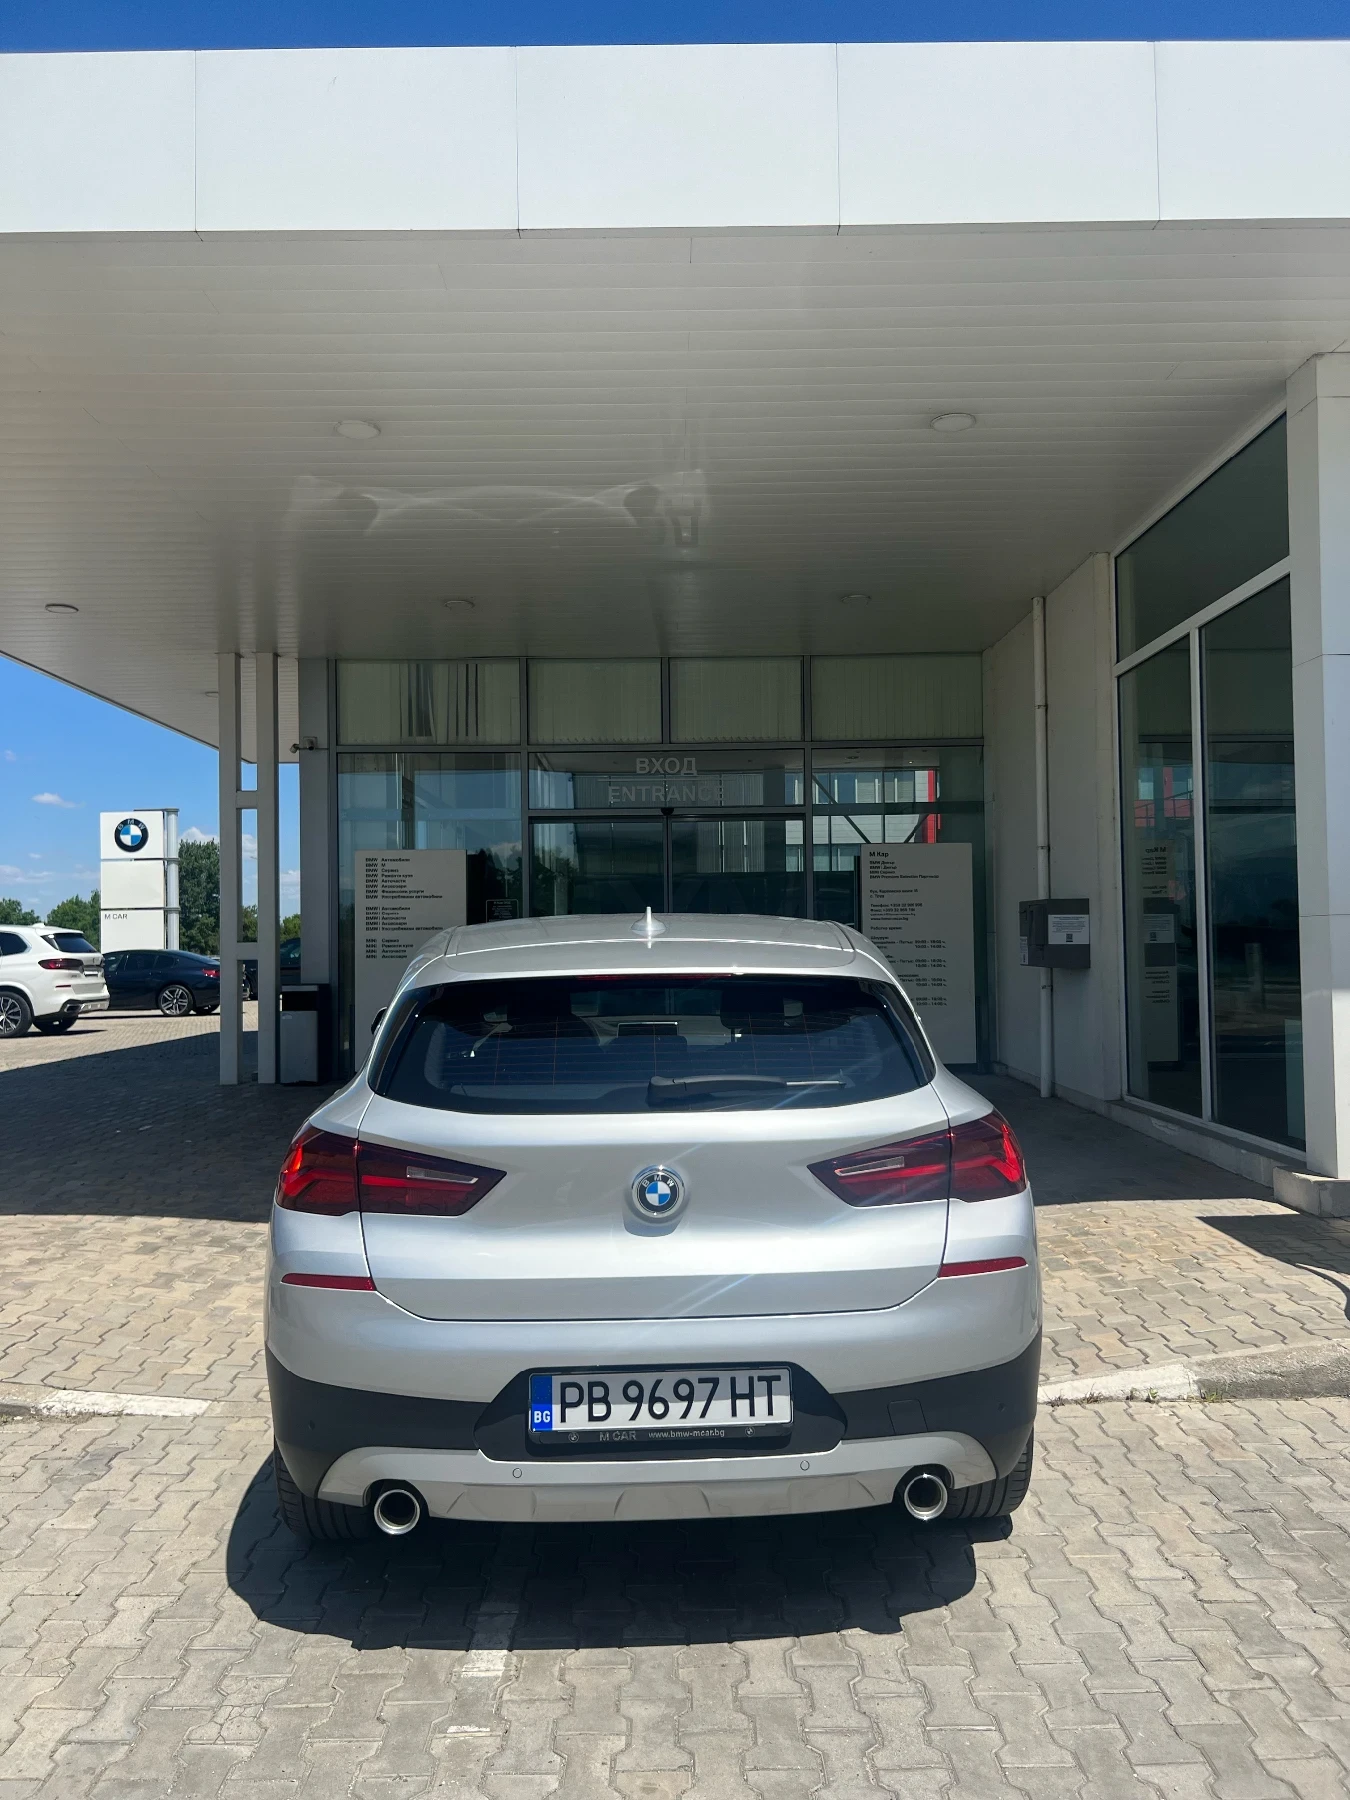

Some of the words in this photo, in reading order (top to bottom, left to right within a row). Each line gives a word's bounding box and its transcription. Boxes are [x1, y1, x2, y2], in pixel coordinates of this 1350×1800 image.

[636, 757, 698, 776] ВХОД
[609, 785, 724, 802] ENTRANCE
[117, 819, 146, 831] BMW
[641, 1174, 675, 1188] BMW
[560, 1381, 612, 1423] PB
[622, 1377, 720, 1421] 9697
[730, 1375, 782, 1418] HT
[533, 1411, 551, 1423] BG
[600, 1432, 610, 1442] M
[612, 1431, 637, 1441] CAR
[648, 1429, 725, 1438] www.bmw-mcar.bg
